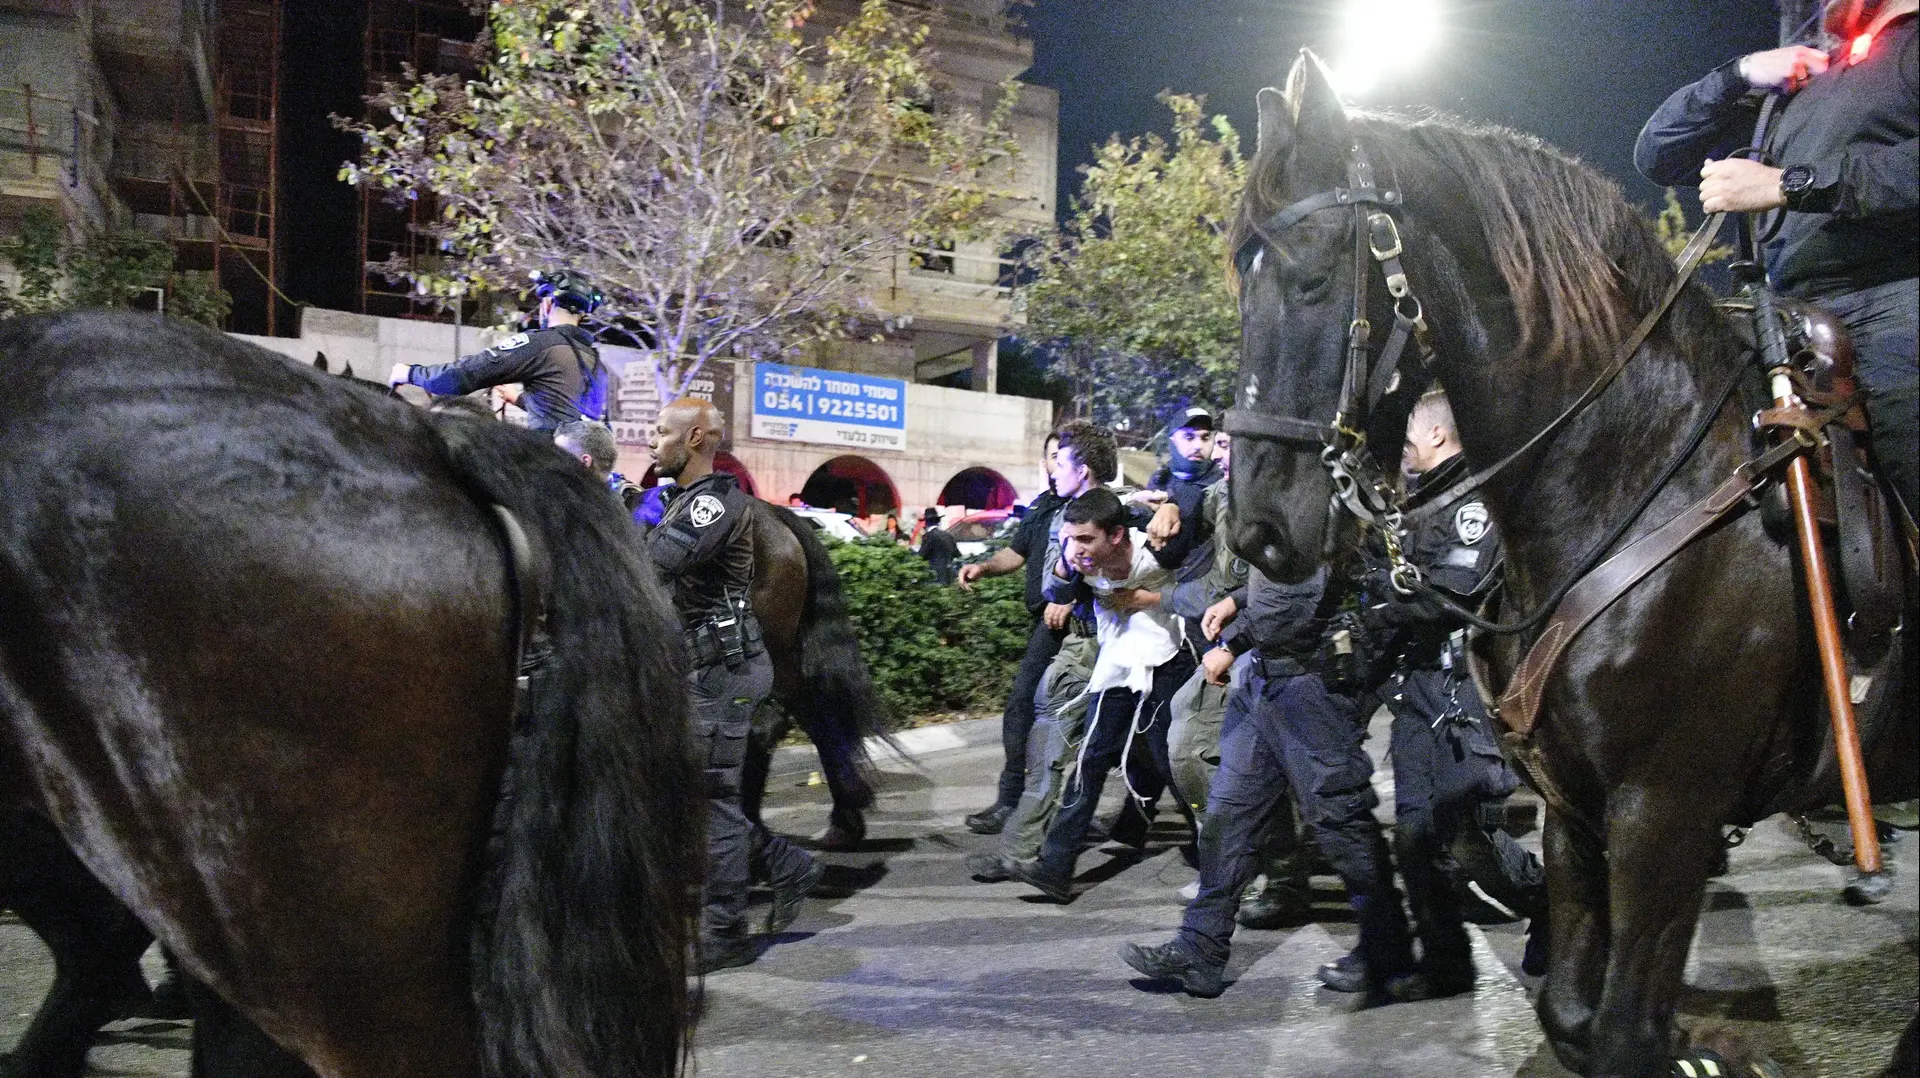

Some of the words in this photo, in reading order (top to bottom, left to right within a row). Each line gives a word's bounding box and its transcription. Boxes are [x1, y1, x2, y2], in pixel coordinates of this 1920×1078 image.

[764, 372, 821, 391] להשכרה
[823, 379, 860, 396] מסחר
[862, 384, 898, 400] שטחי
[764, 391, 803, 411] 054
[818, 397, 898, 422] 9225501
[836, 430, 867, 442] בלעדי
